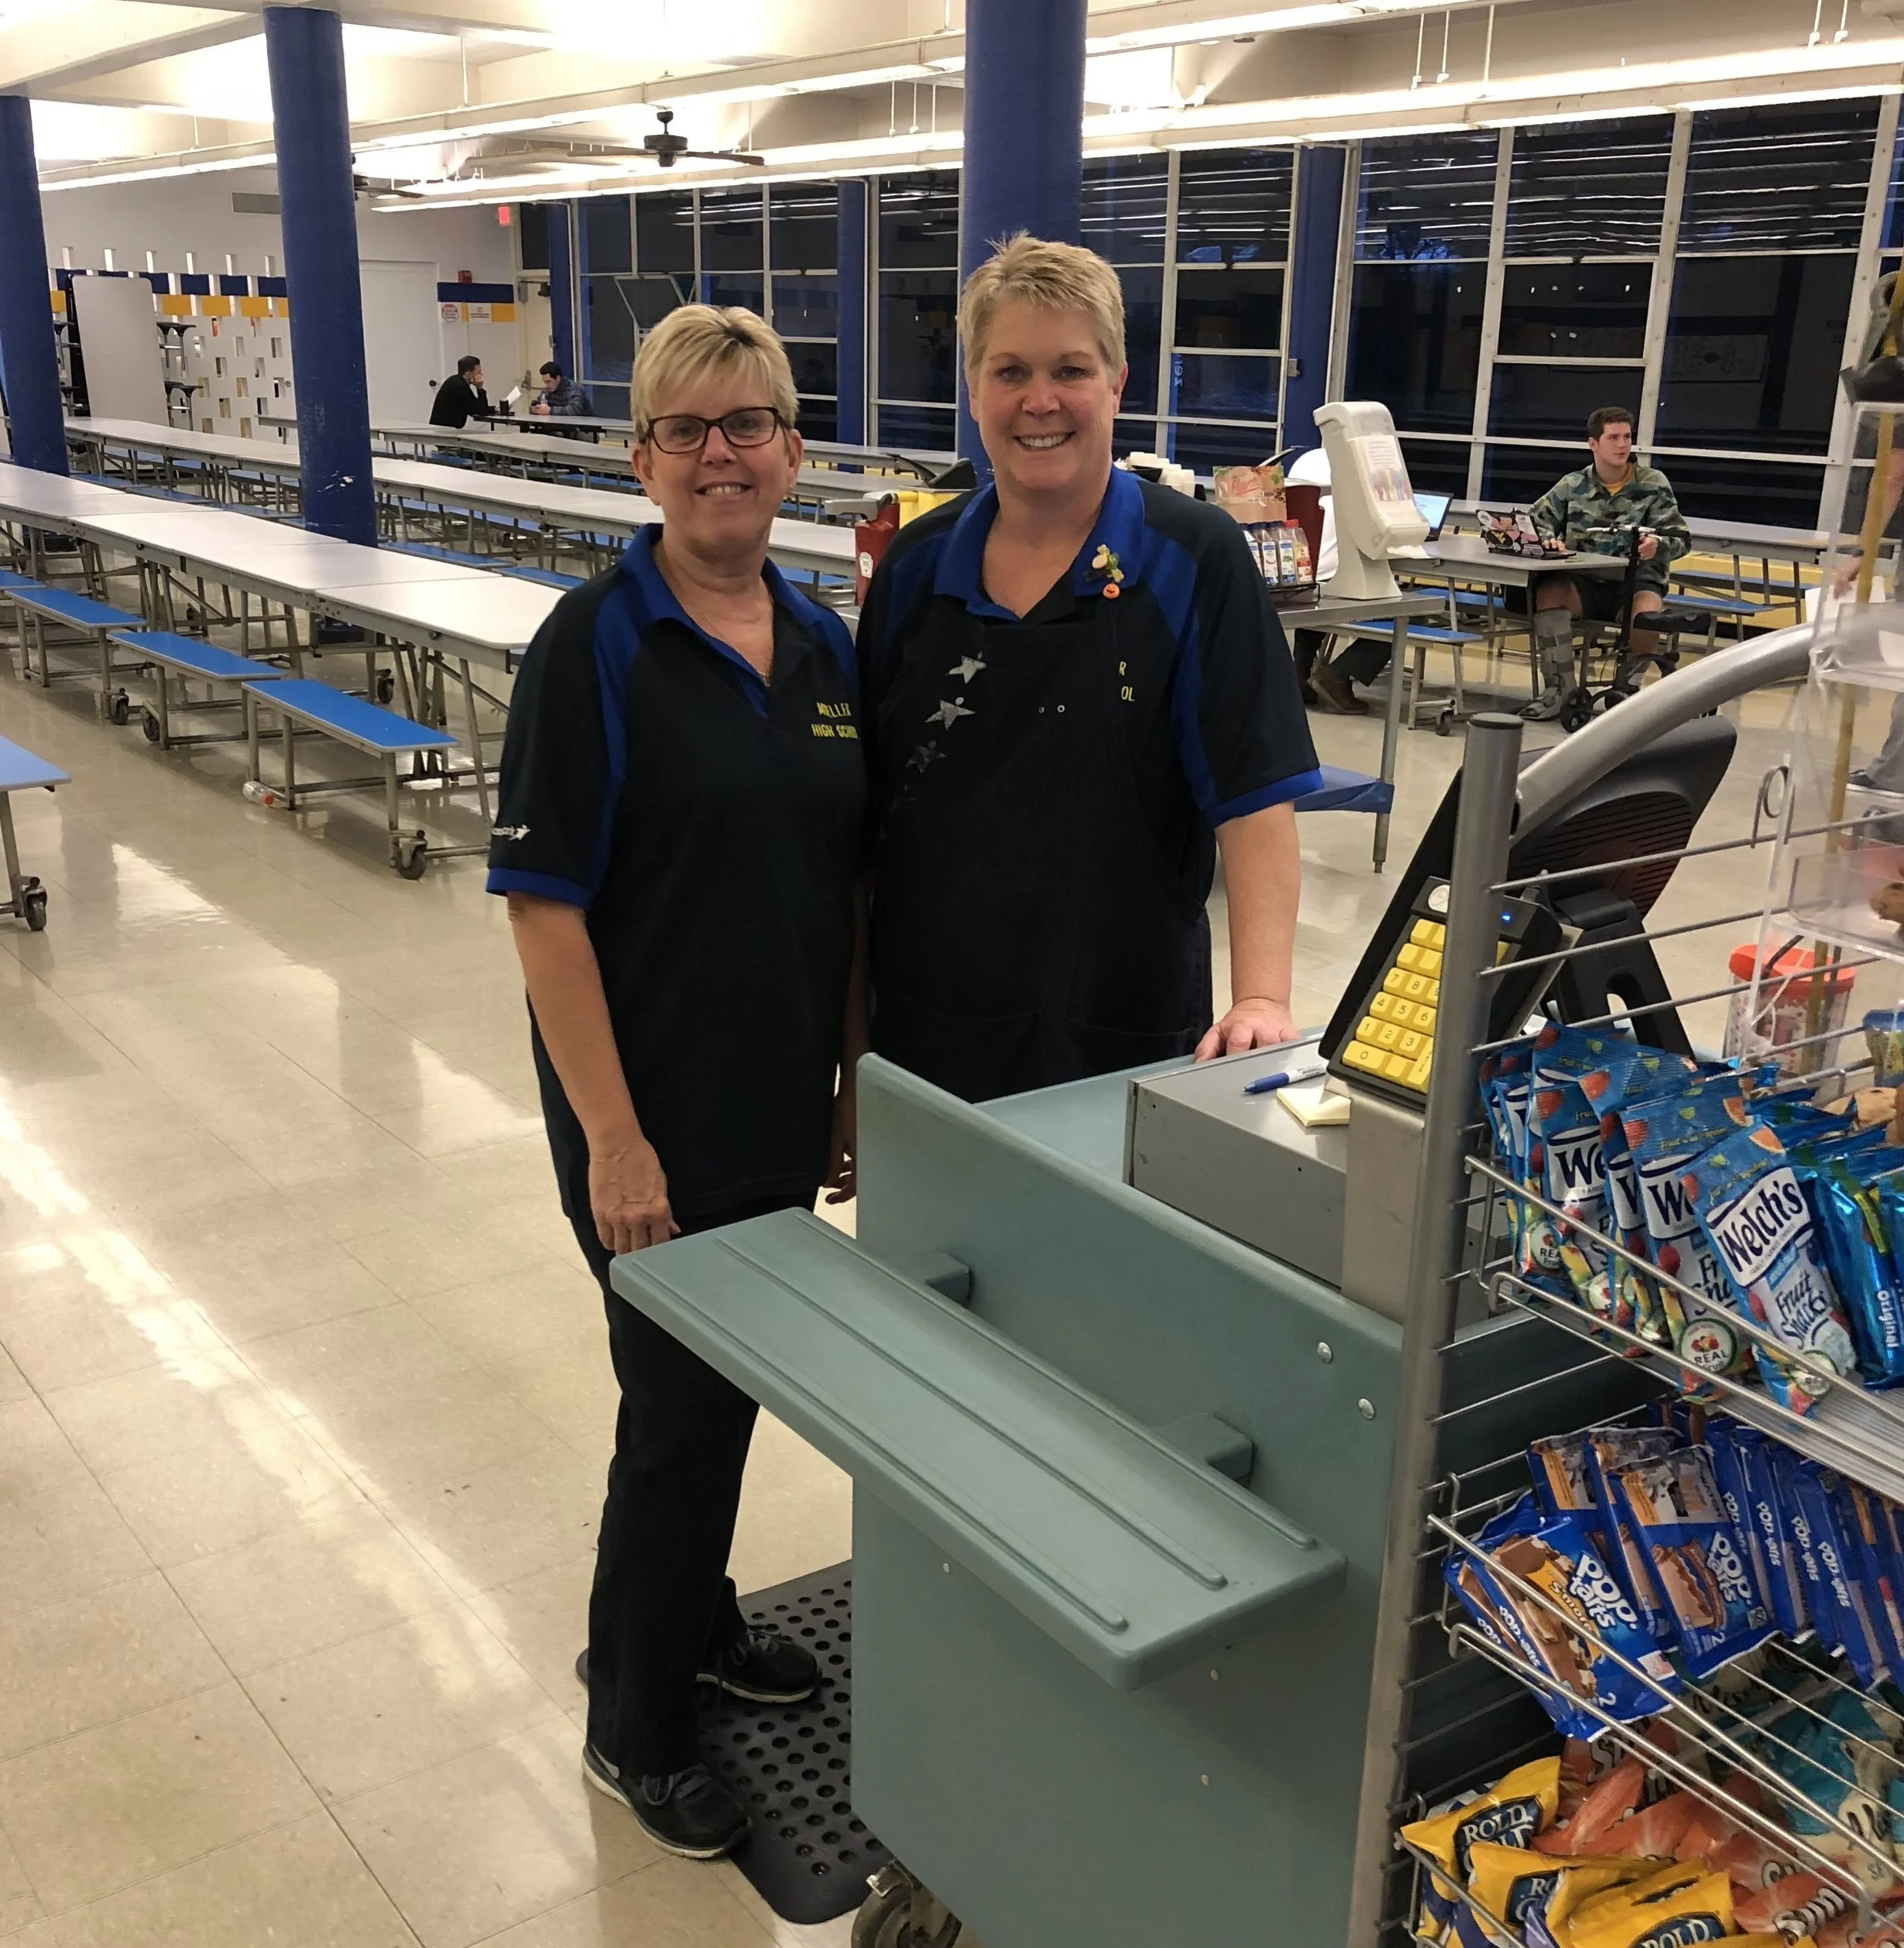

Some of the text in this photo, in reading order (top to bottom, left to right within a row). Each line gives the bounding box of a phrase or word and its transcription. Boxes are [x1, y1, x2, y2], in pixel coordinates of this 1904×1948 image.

[811, 724, 835, 737] HIGH
[1391, 973, 1400, 983] 7
[1412, 981, 1420, 990] 8
[1398, 1005, 1407, 1014] 5
[1420, 1012, 1429, 1021] 6
[1384, 1030, 1393, 1039] 2
[1405, 1037, 1415, 1047] 3
[1717, 1180, 1803, 1272] Welch's
[1693, 1349, 1729, 1364] REAL
[1569, 1576, 1617, 1627] tarts
[1712, 1631, 1726, 1647] 2
[1599, 1692, 1617, 1708] 2
[1462, 1804, 1535, 1846] ROLD
